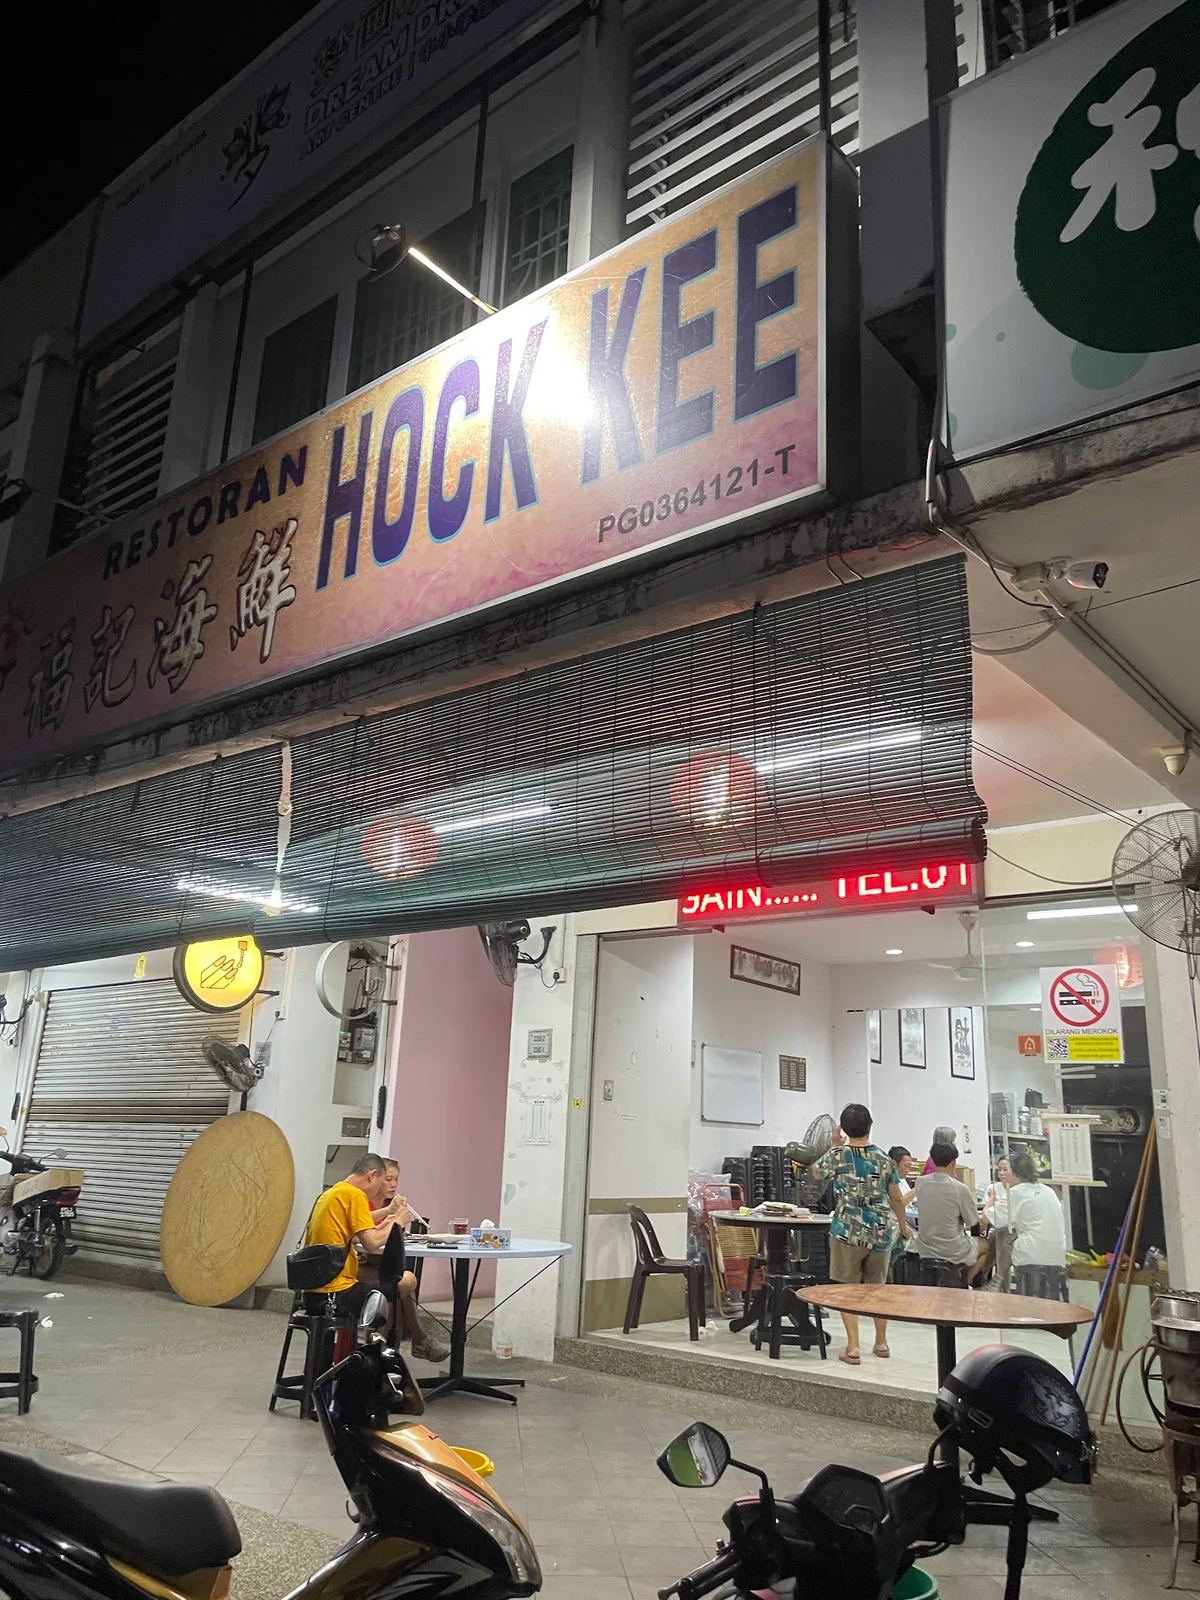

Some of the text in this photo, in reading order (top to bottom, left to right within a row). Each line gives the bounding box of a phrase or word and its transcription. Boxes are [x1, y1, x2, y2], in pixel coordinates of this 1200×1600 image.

[304, 25, 410, 135] DREAM
[334, 66, 403, 131] CENTRE
[315, 183, 800, 592] HOCK KEE
[103, 445, 307, 580] RESTORAN
[598, 444, 796, 544] PG0364121-T
